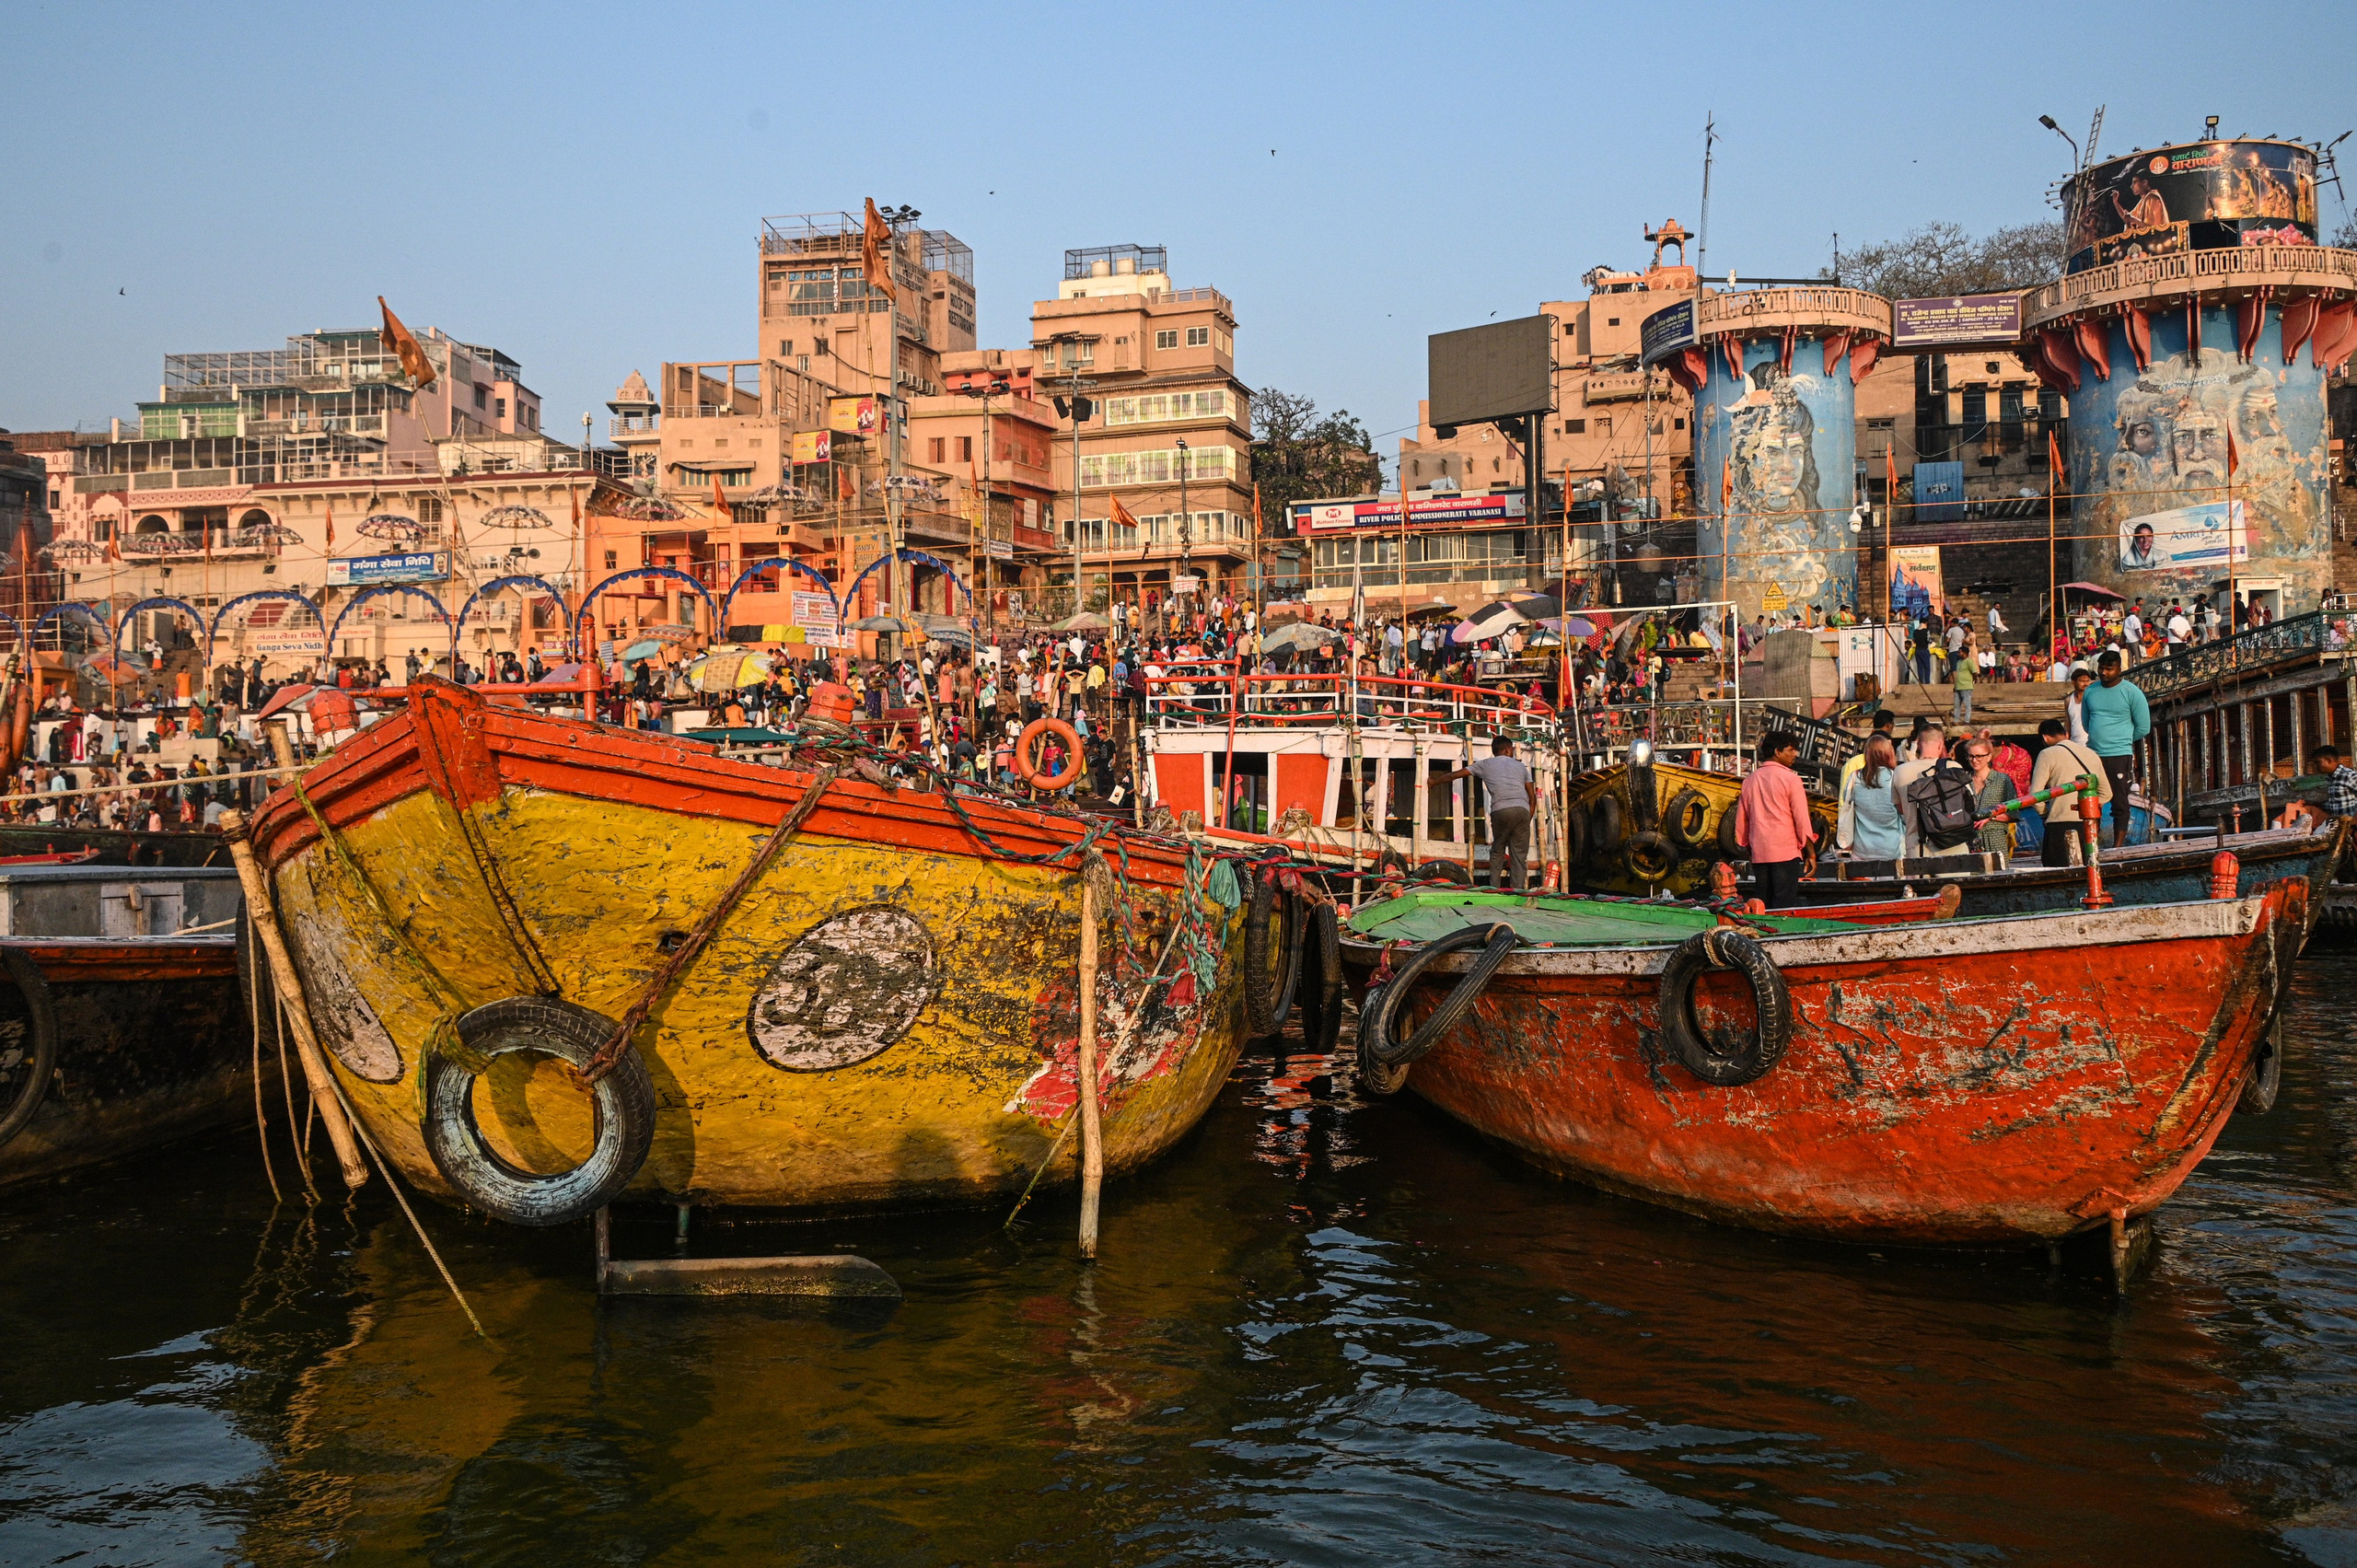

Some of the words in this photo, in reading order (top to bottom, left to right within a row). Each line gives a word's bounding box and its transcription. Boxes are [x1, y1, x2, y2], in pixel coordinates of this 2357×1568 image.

[2171, 151, 2190, 162] स्मार्ट
[2191, 149, 2209, 158] सिटी
[2171, 154, 2223, 170] वाराणसी
[1415, 501, 1451, 510] कमिश्नरेट
[1452, 498, 1482, 507] वाराणसी
[1381, 514, 1402, 522] POLIC
[1410, 510, 1467, 520] OMMISSIONERATE
[1469, 508, 1502, 517] VARANASI
[2170, 528, 2206, 541] AMRIT
[353, 560, 377, 570] गंगा
[380, 558, 402, 569] सेवा
[405, 555, 431, 567] निधि
[301, 631, 322, 639] निधि
[256, 644, 281, 652] Ganga
[304, 642, 323, 650] Nidh
